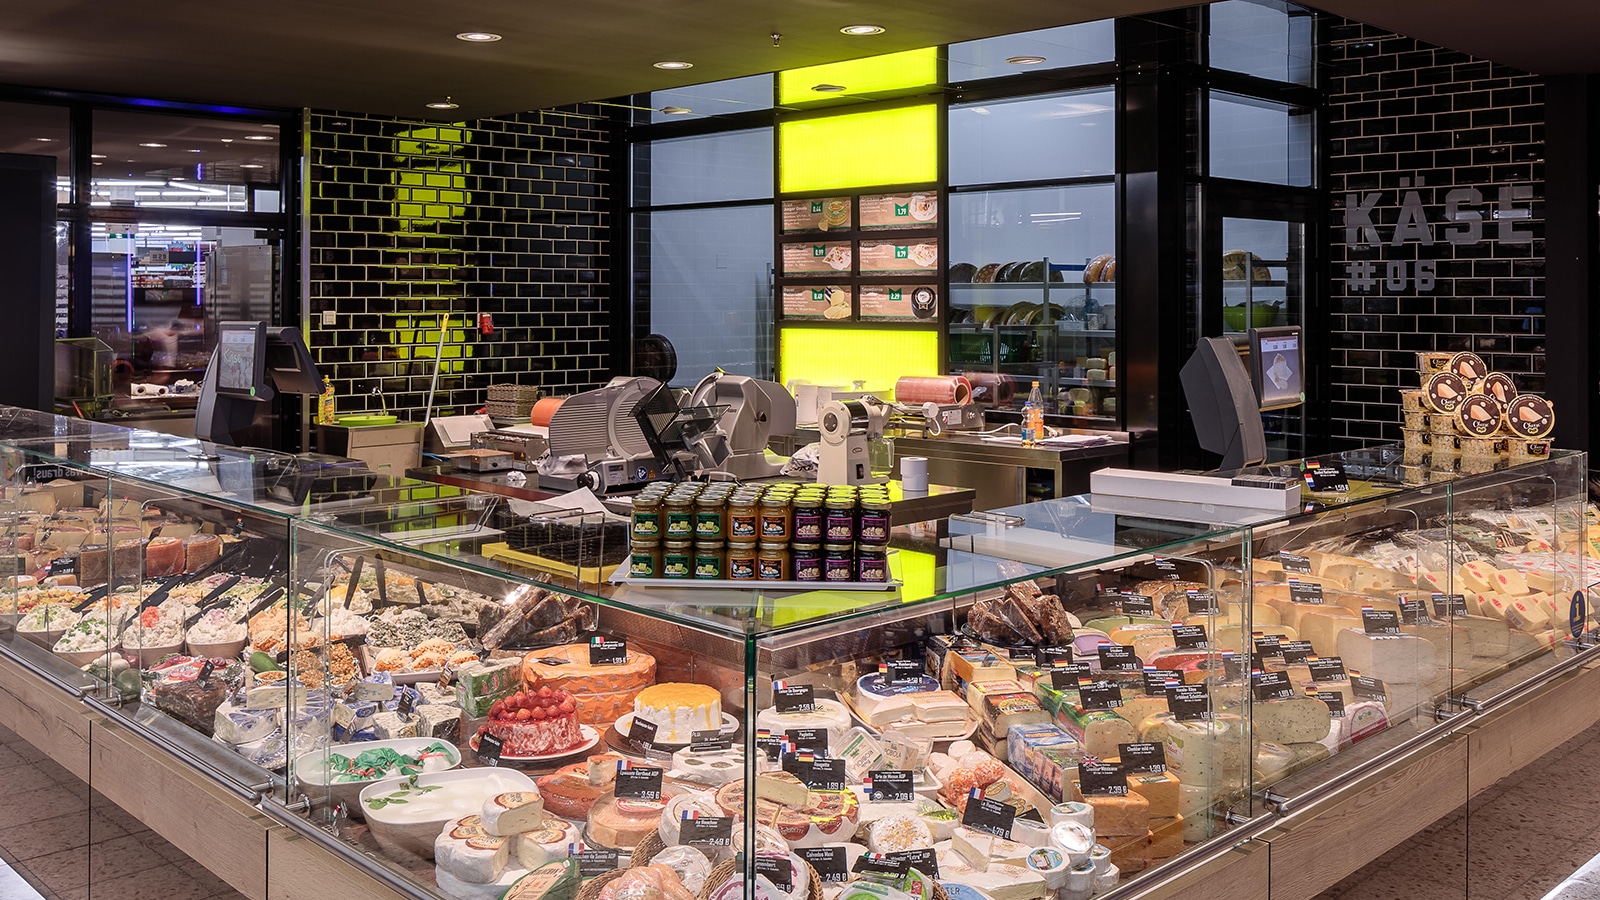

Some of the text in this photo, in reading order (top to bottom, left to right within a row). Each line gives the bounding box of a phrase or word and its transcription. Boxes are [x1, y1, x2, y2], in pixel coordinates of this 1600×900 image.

[1345, 176, 1533, 247] KÄSE
[1345, 259, 1435, 291] #06
[1472, 420, 1490, 428] Cheese
[1523, 421, 1541, 430] Cheese
[641, 790, 655, 799] 3.59
[1108, 786, 1121, 794] 2.39
[825, 873, 841, 882] 2.49
